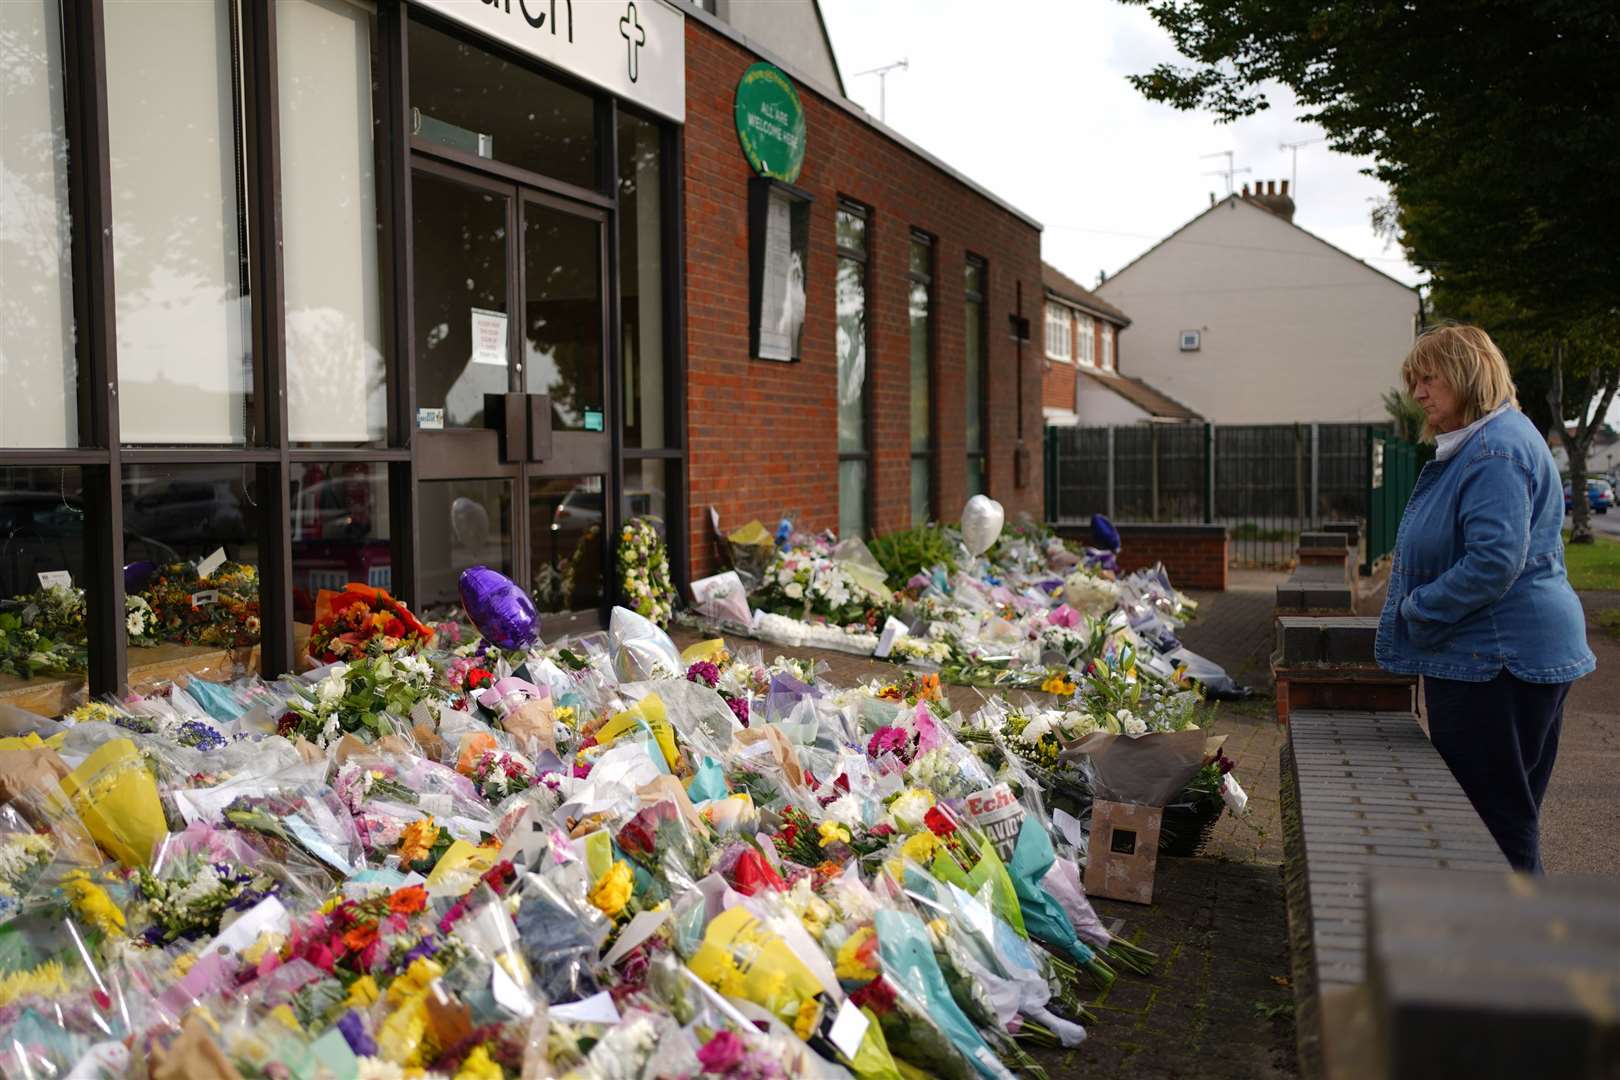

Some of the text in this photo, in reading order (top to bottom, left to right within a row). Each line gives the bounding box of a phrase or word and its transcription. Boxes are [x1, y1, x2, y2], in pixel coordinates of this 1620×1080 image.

[760, 101, 789, 127] ALL ARE
[747, 112, 799, 150] WELCOME HERE
